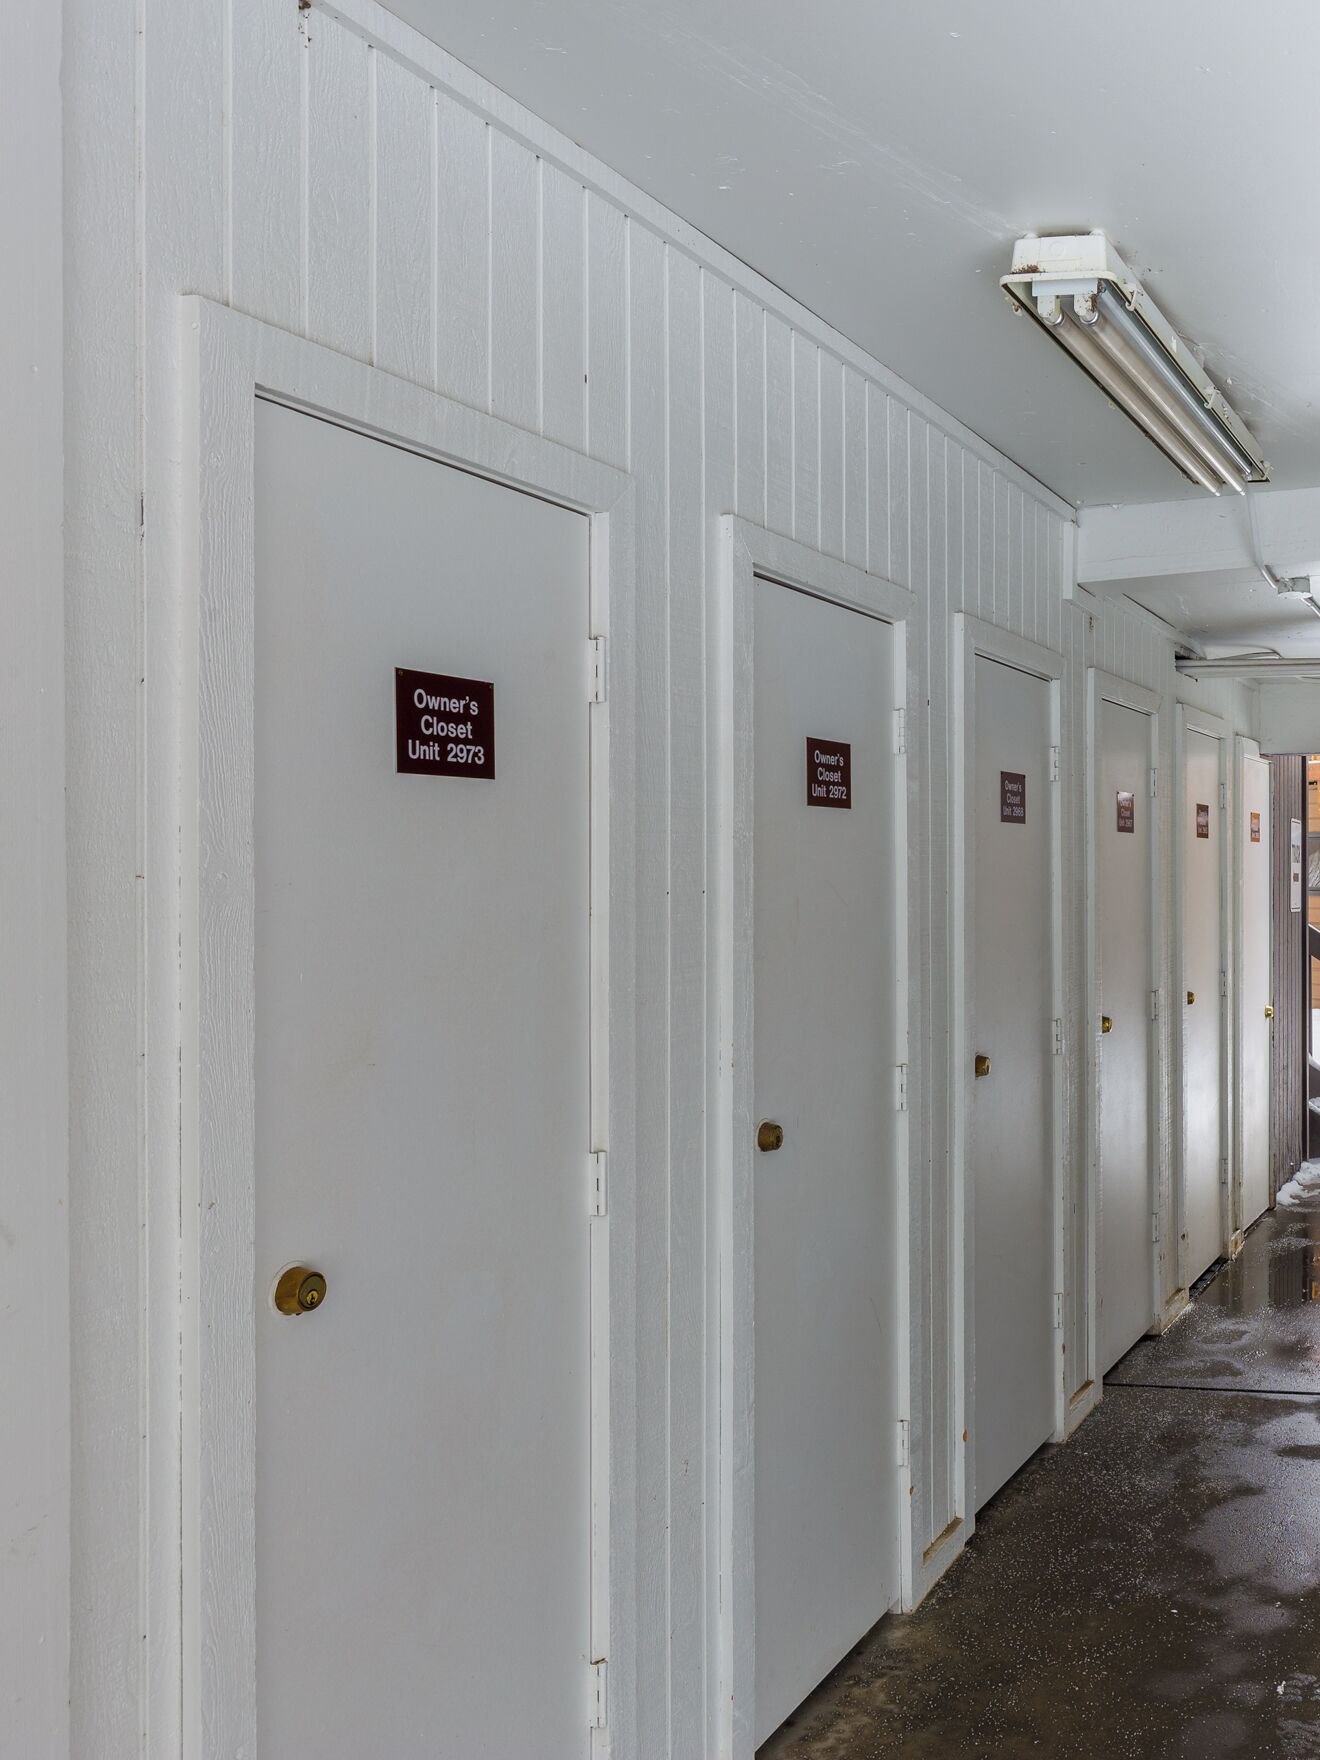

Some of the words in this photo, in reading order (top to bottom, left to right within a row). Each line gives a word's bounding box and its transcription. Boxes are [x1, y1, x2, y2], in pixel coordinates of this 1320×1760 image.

[414, 688, 479, 716] Owner's
[421, 715, 473, 739] Closet
[408, 739, 440, 761] Unit
[447, 743, 485, 765] 2973
[814, 750, 844, 767] Owner's
[818, 767, 842, 782] Closet
[812, 784, 826, 797] Unit
[829, 786, 847, 799] 2972
[1002, 806, 1012, 816] Unit
